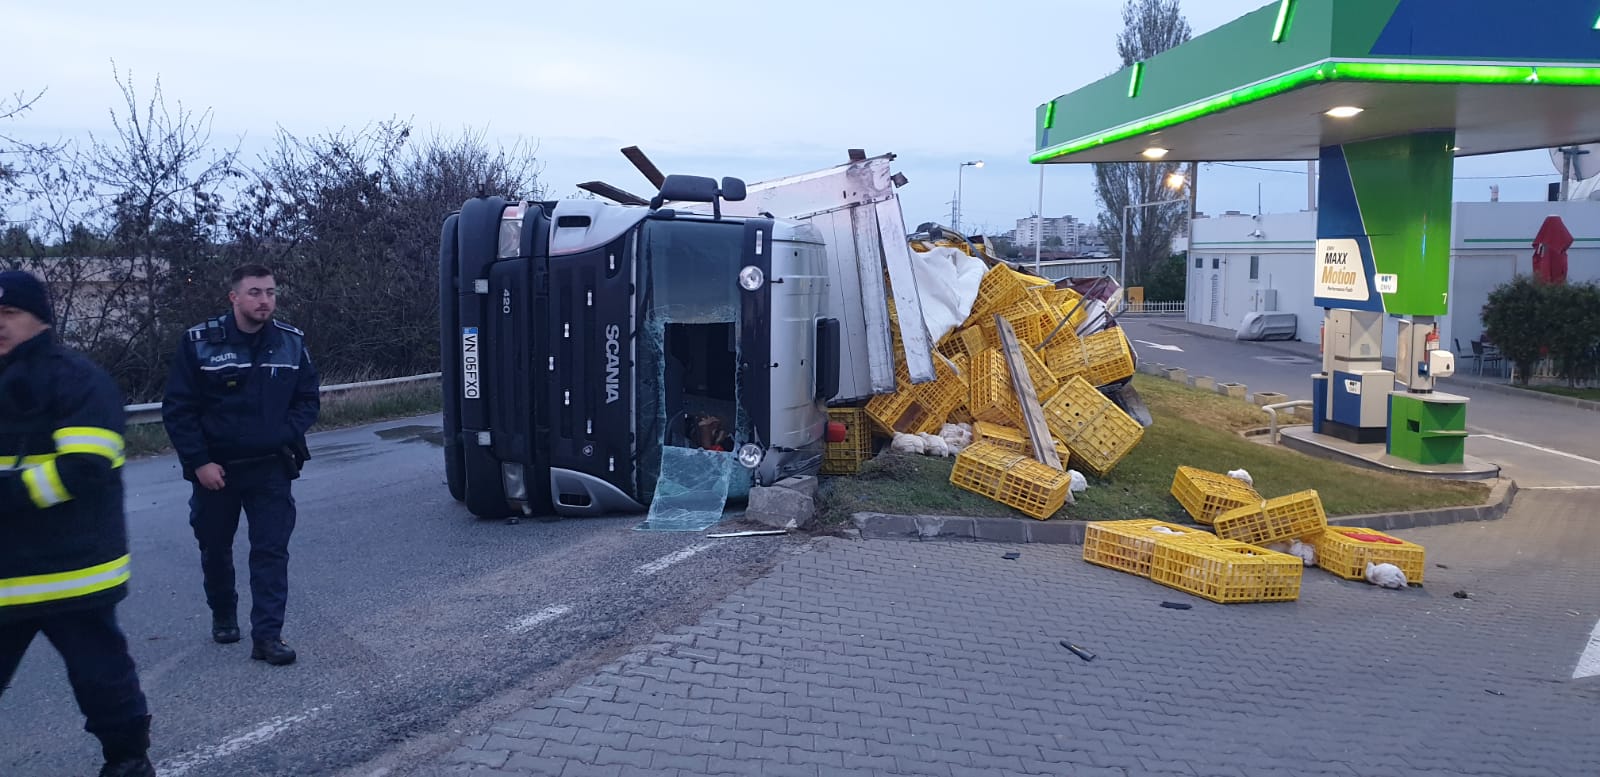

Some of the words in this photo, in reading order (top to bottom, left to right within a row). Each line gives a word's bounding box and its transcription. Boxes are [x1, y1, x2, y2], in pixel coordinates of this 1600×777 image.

[1324, 252, 1348, 265] MAXX
[1321, 265, 1357, 286] Motion
[503, 288, 511, 314] 420
[1441, 292, 1448, 305] 7
[464, 335, 476, 352] VN
[605, 324, 620, 404] SCANIA
